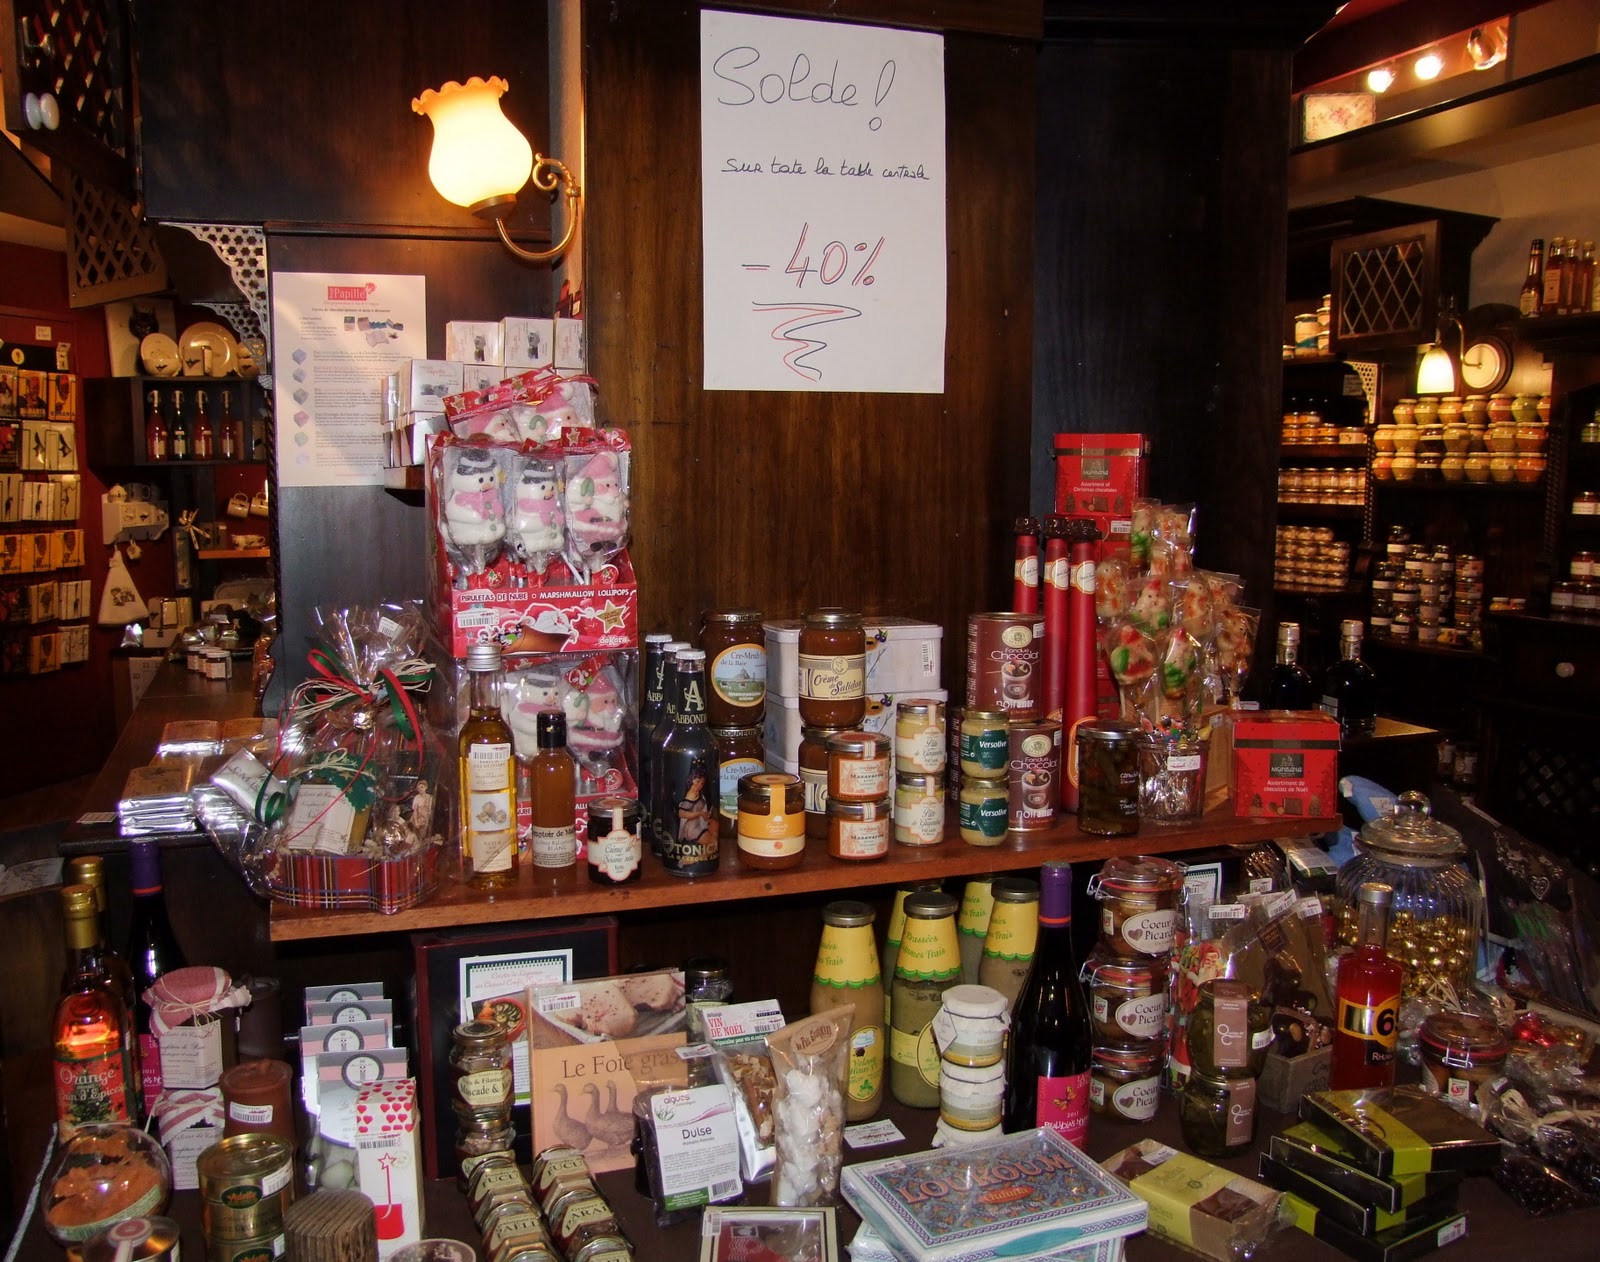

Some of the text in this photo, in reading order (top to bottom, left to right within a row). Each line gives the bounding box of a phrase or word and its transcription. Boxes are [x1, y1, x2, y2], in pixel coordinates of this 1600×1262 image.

[814, 157, 836, 176] la
[840, 159, 874, 177] table
[334, 287, 366, 300] Papille
[460, 592, 529, 602] PIRULETAS DE NUBE
[539, 588, 630, 600] MARSHMALLOW LOLLIPOPS
[814, 675, 840, 687] Crème
[708, 1017, 723, 1027] VIN
[710, 1021, 746, 1038] DE NOËL
[562, 1052, 679, 1079] Le Foie gras
[60, 1067, 117, 1086] Orange
[492, 1083, 500, 1094] &
[663, 1092, 691, 1105] algues
[1066, 1110, 1079, 1118] 2011
[681, 1126, 713, 1140] Dulse
[547, 1160, 583, 1177] FUCU
[482, 1175, 519, 1188] FUCU
[895, 1153, 1078, 1204] LOUKOUM
[496, 1221, 538, 1240] PAELL
